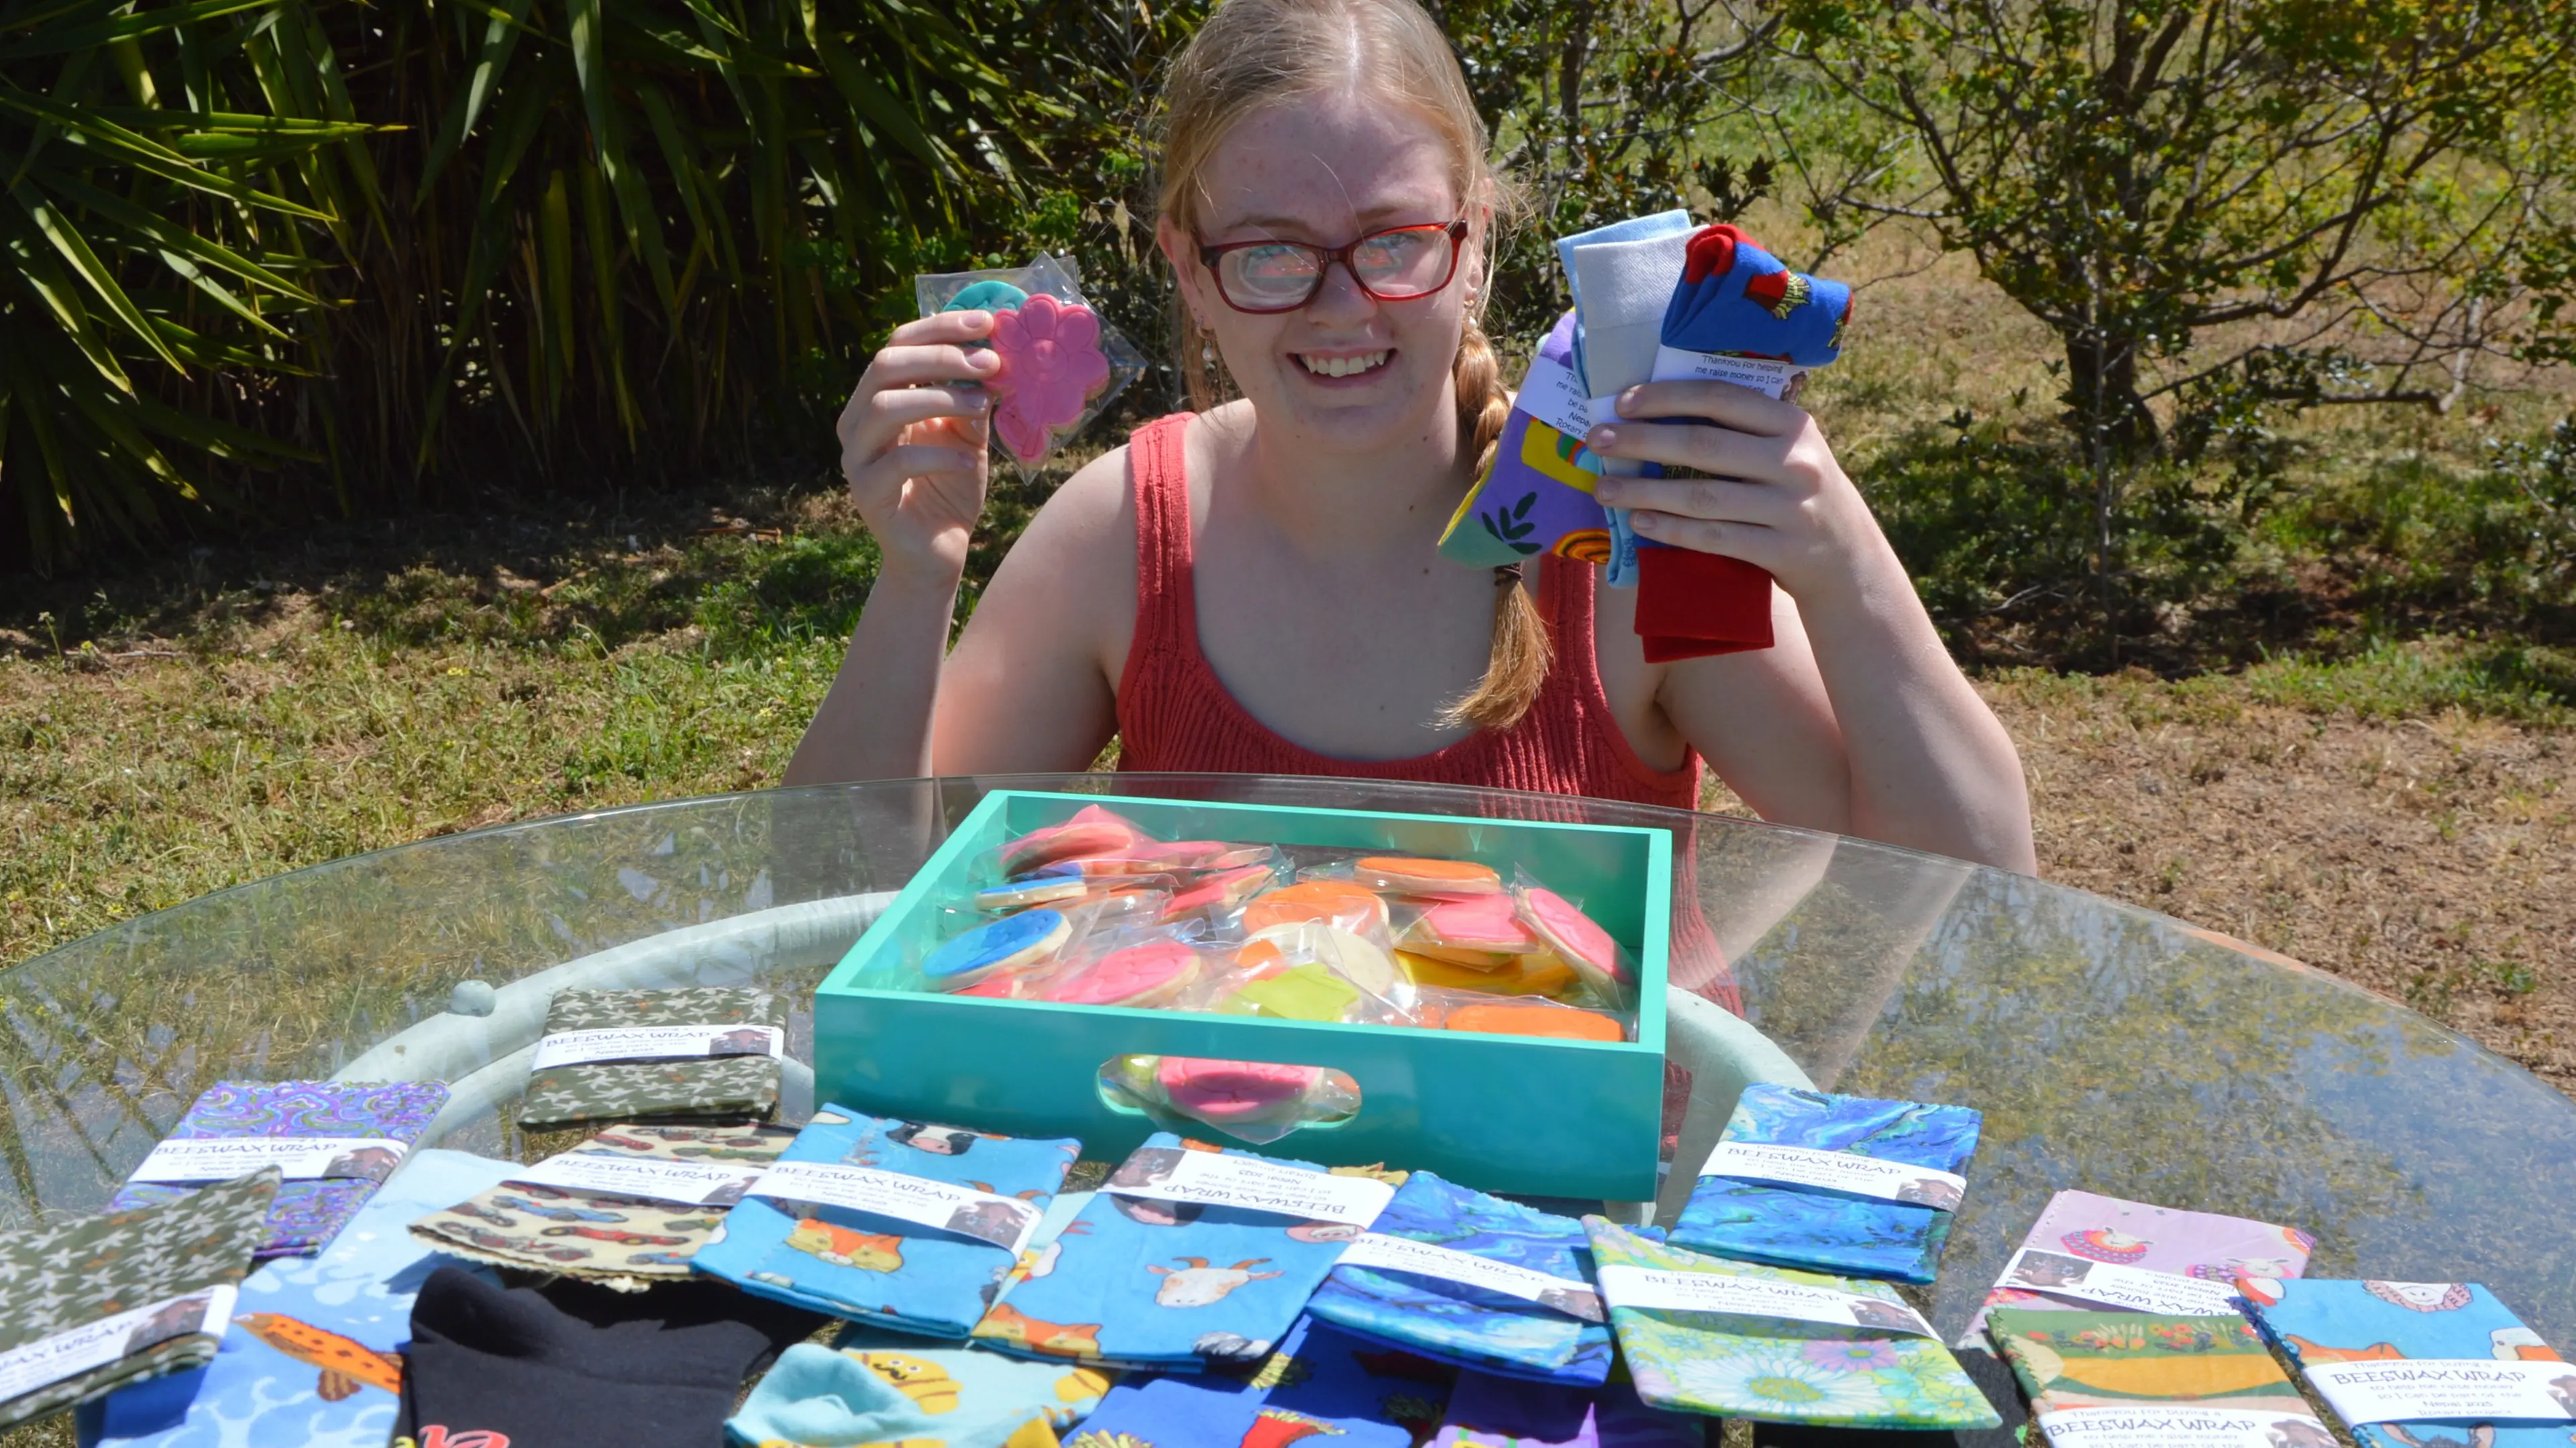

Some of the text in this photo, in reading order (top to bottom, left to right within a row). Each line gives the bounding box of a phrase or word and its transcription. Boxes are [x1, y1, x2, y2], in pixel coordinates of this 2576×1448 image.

[1702, 355, 1741, 368] Thankyou
[1757, 362, 1783, 374] helping
[1695, 366, 1707, 374] me
[1709, 369, 1728, 378] raise
[1729, 371, 1754, 382] money
[1756, 375, 1765, 383] so
[1766, 376, 1769, 384] I
[1556, 381, 1568, 390] me
[1568, 398, 1578, 408] be
[1556, 418, 1583, 435] Rotary
[546, 1033, 645, 1047] BEESWAX
[154, 1144, 337, 1155] BEESWAX WRAP
[1727, 1148, 1901, 1174] BEESWAX WRAP
[555, 1160, 662, 1175] BEESWAX
[665, 1170, 731, 1181] WRAP
[775, 1167, 889, 1186] BEESWAX
[893, 1181, 961, 1201] WRAP
[1164, 1185, 1345, 1213] BEESWAX WRAP
[1645, 1275, 1763, 1293] BEESWAX
[1769, 1286, 1840, 1301] WRAP
[2080, 1288, 2151, 1305] WRAP
[55, 1321, 133, 1353] WRAP
[2349, 1361, 2413, 1369] Thankyou
[2440, 1361, 2481, 1369] buying
[2330, 1370, 2526, 1384] BEESWAX WRAP
[2166, 1408, 2208, 1416] buying
[2046, 1418, 2256, 1437] BEESWAX WRAP
